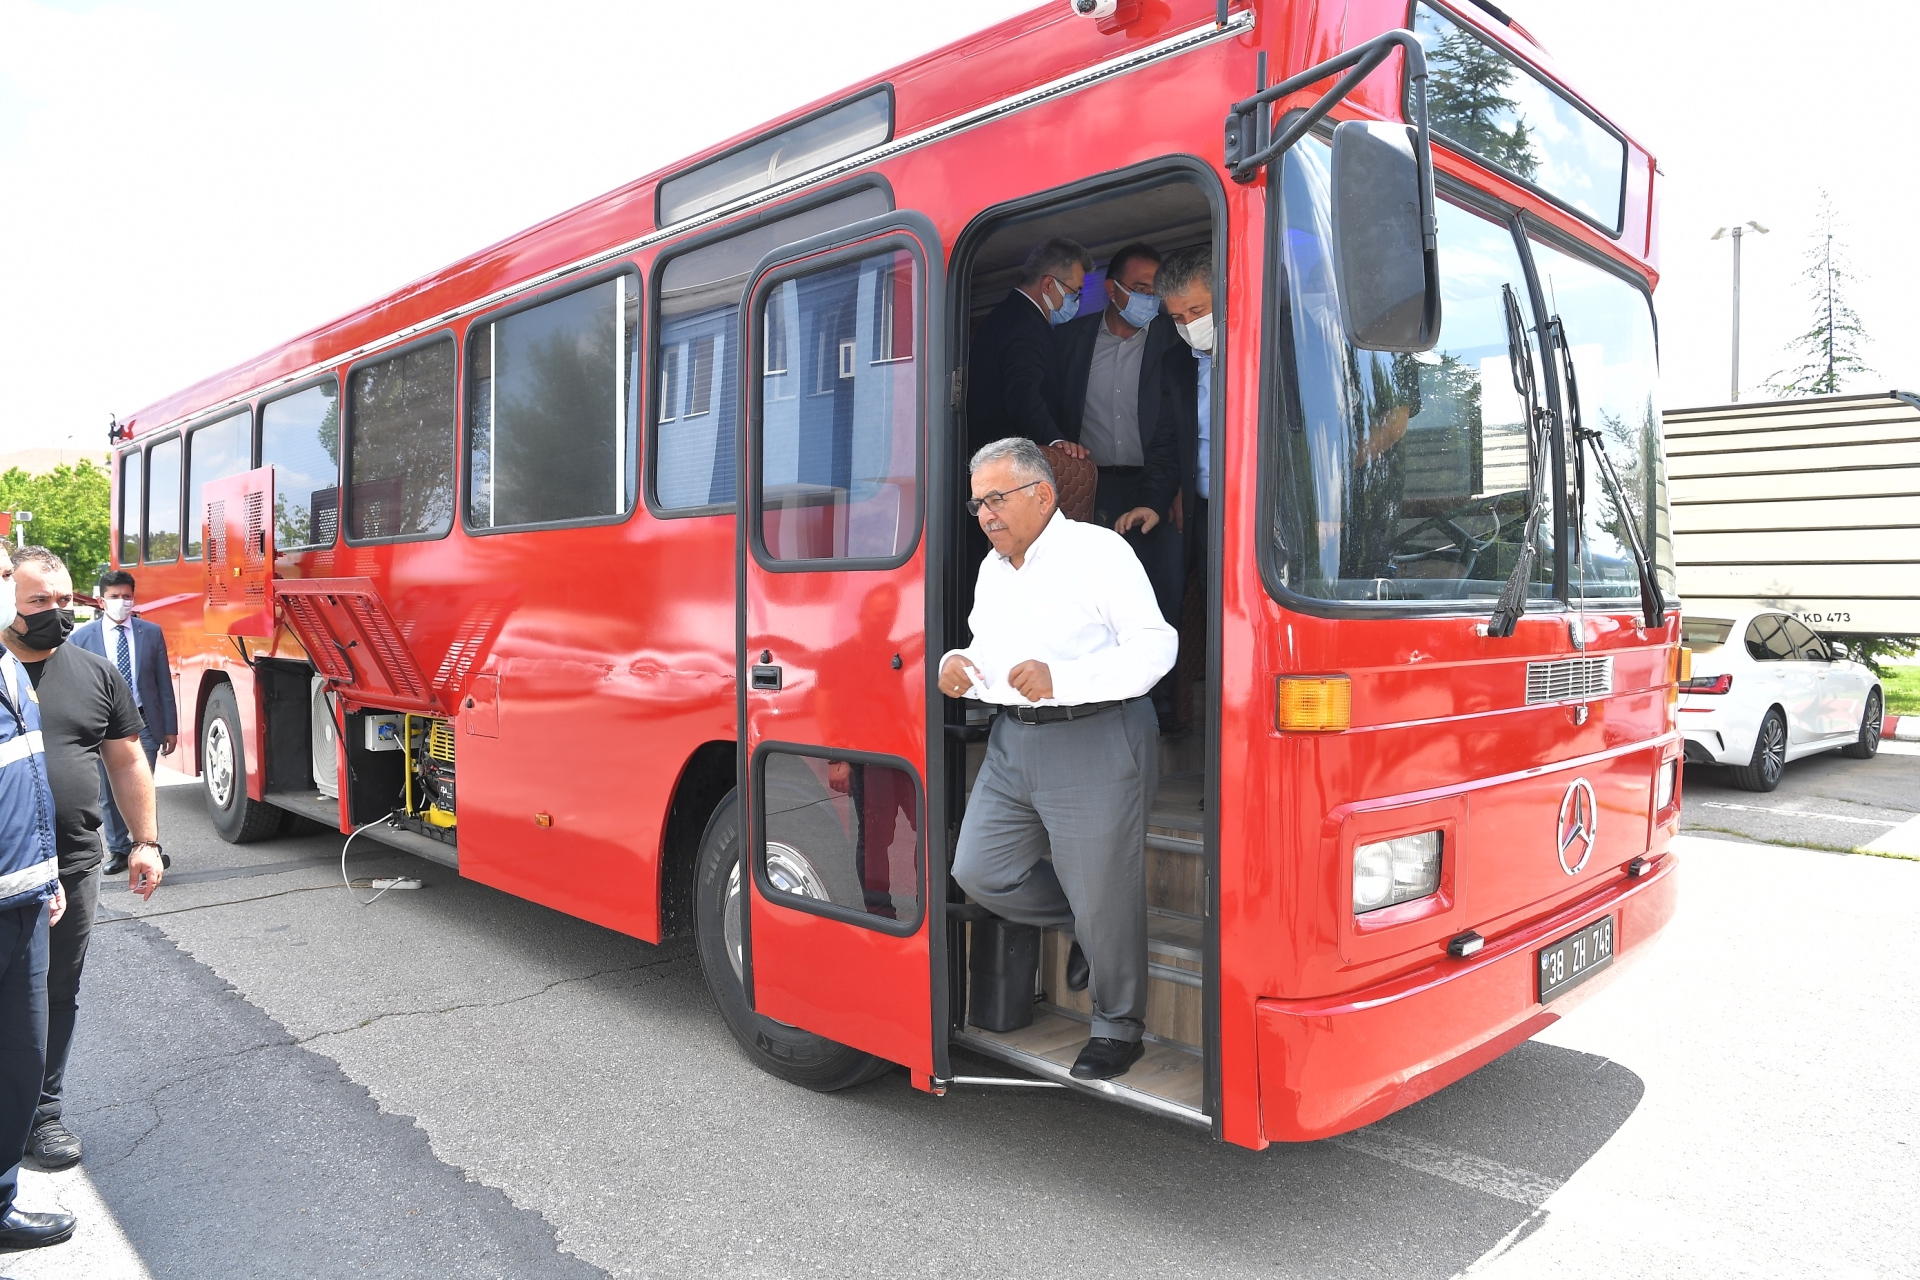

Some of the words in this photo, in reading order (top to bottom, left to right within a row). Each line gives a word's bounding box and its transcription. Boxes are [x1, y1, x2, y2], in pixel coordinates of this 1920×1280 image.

[1803, 613, 1822, 623] KD
[1826, 612, 1851, 623] 473
[1549, 949, 1564, 985] 38
[1572, 936, 1586, 973] ZH
[1592, 923, 1611, 961] 748
